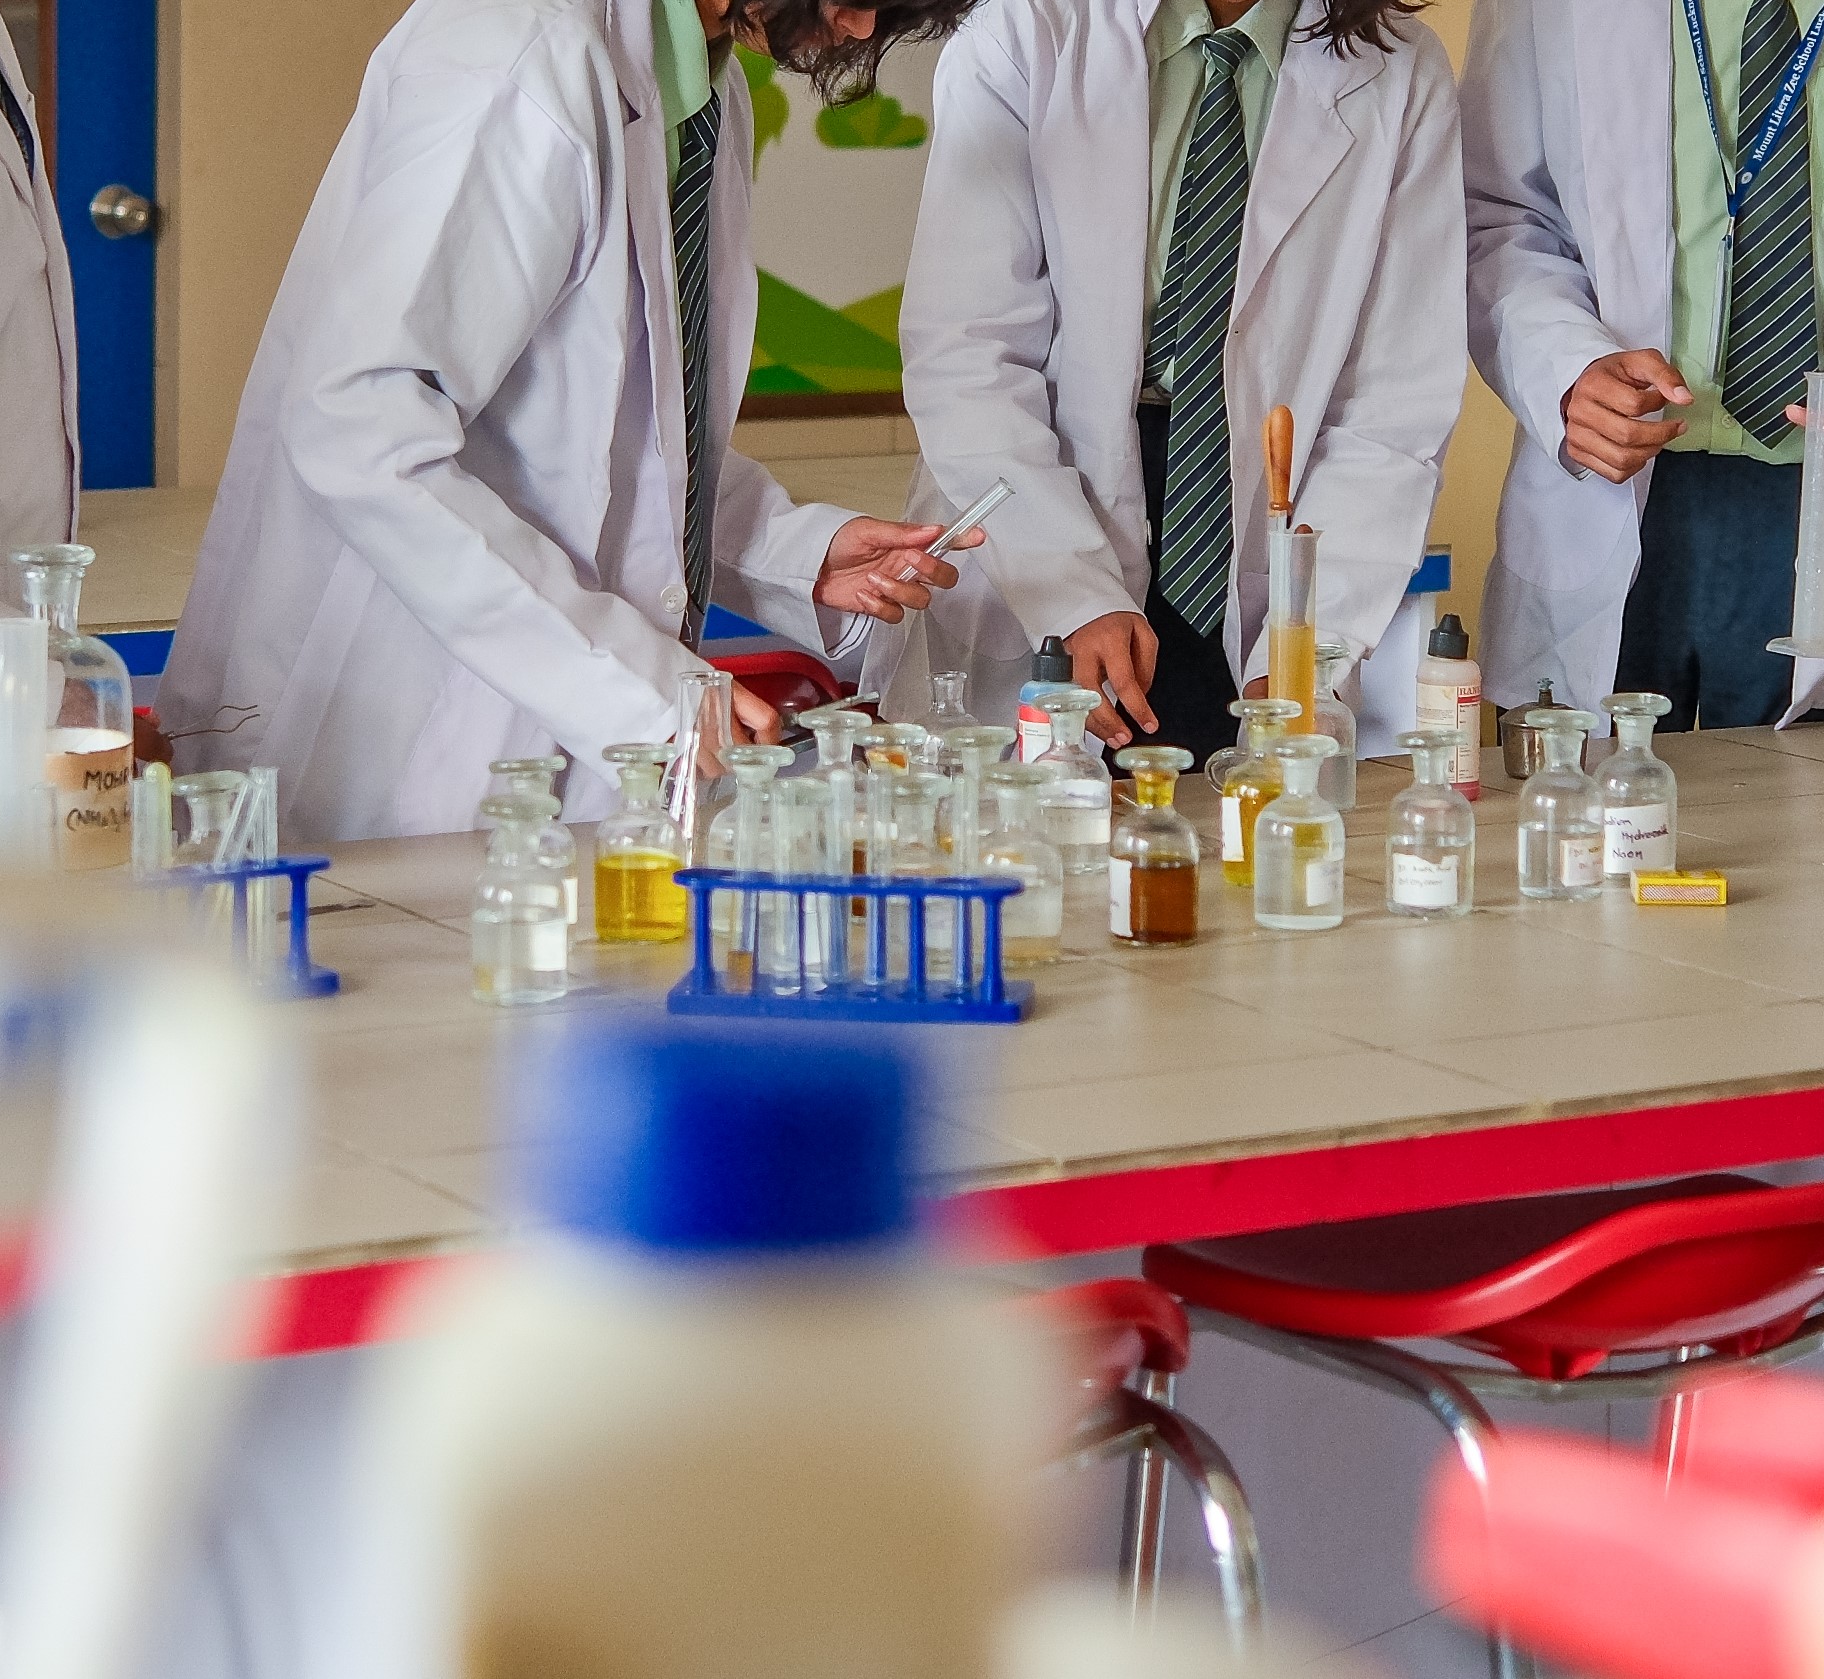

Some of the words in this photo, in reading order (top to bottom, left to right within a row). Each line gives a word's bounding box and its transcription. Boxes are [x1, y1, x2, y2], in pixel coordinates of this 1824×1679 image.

[1693, 36, 1707, 75] School
[1752, 128, 1778, 162] Mount
[1769, 93, 1793, 127] Litera
[1783, 73, 1801, 94] Zee
[1793, 37, 1817, 74] School
